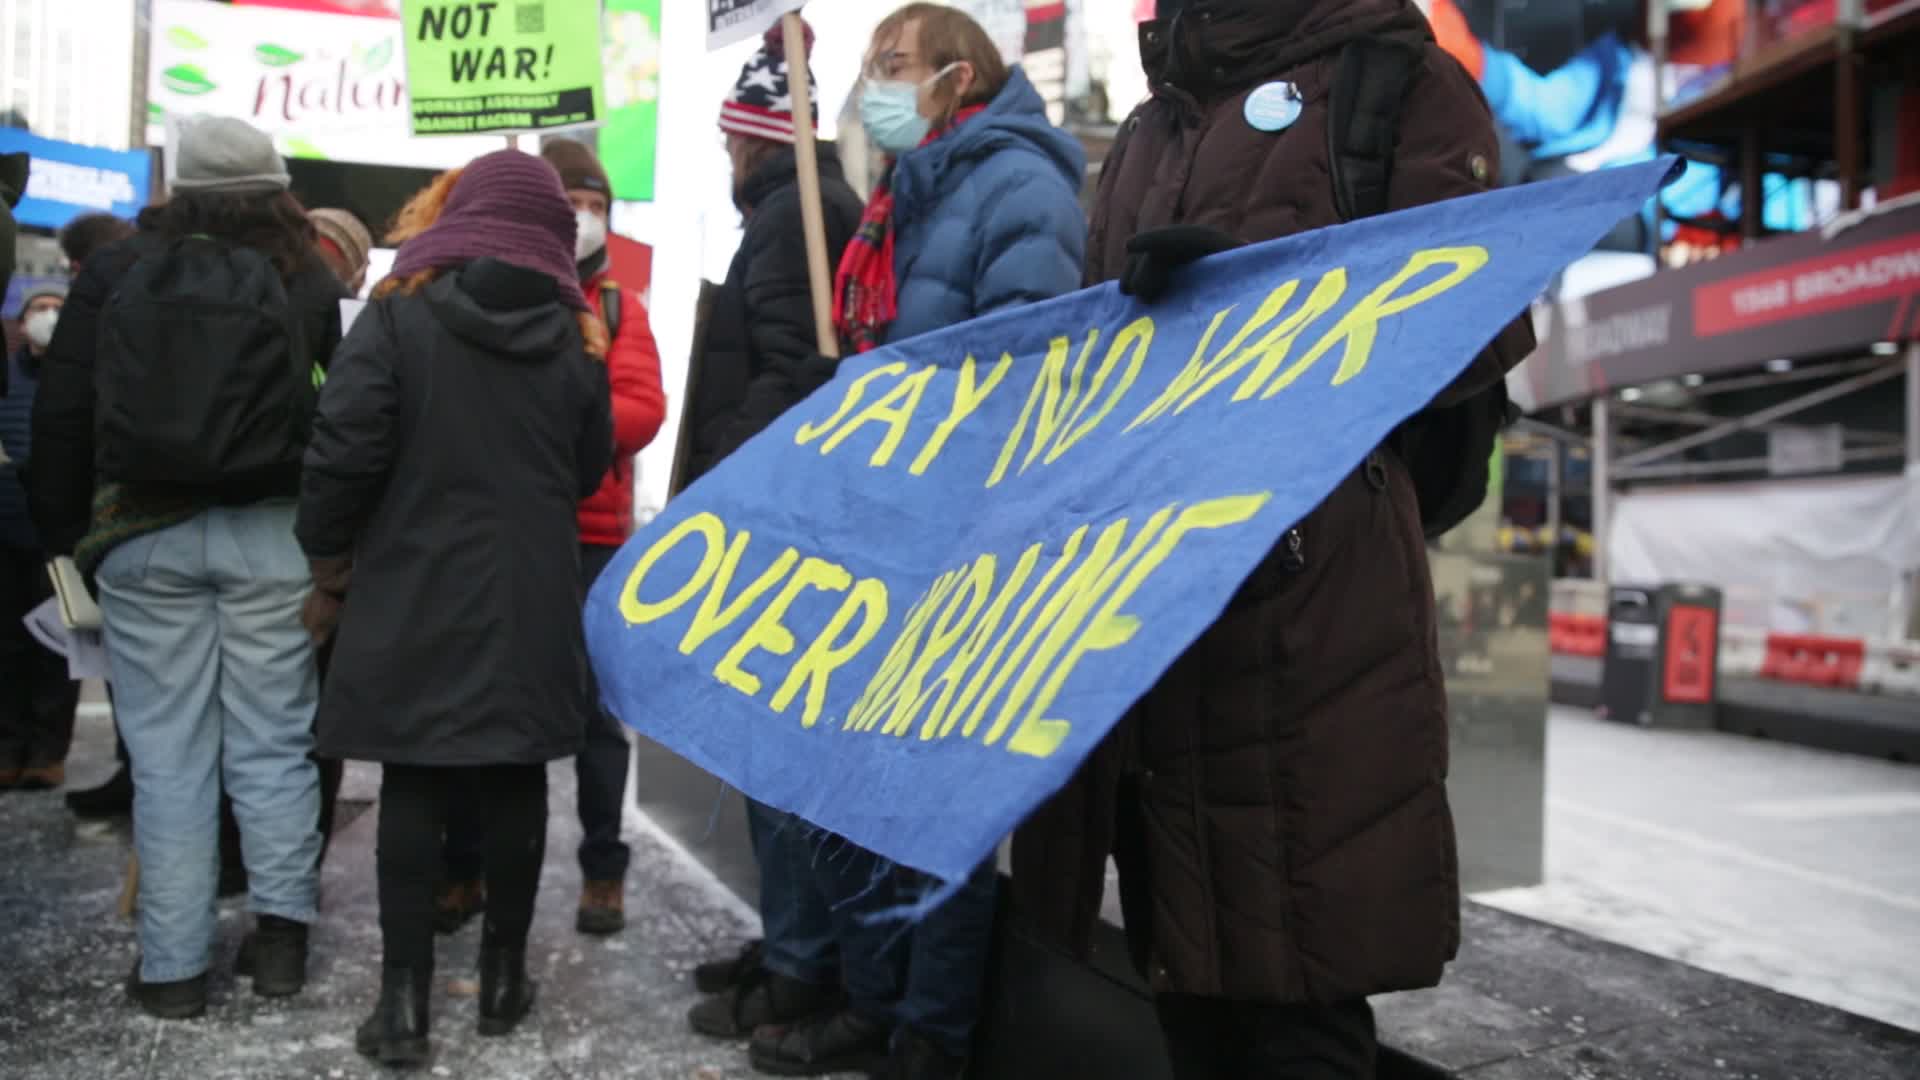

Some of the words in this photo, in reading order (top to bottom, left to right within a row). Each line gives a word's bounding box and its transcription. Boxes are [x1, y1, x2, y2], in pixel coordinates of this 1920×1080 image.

[418, 2, 498, 41] NOT
[451, 44, 554, 83] WAR!
[796, 354, 1013, 475] SAY
[990, 316, 1155, 485] NO
[1121, 246, 1488, 435] WAR
[619, 512, 888, 728] OVER
